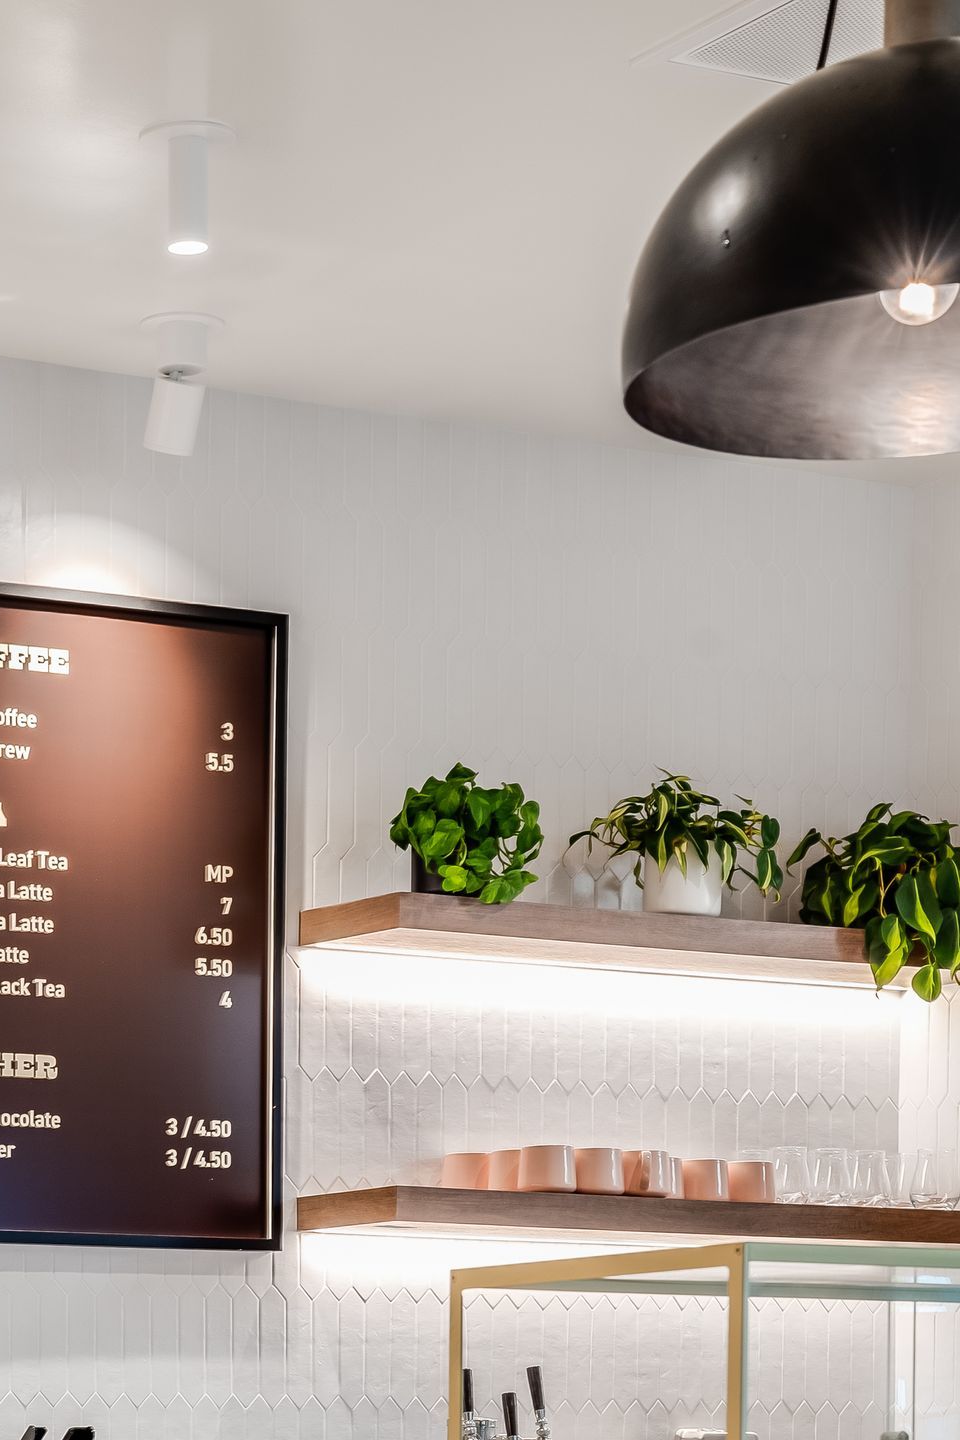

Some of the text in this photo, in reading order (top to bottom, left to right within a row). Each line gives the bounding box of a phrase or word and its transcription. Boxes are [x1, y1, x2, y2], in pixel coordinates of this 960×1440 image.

[220, 723, 234, 741] 3
[205, 752, 234, 772] 5.5
[36, 851, 69, 871] Tea
[205, 864, 234, 884] MP
[8, 880, 53, 902] Latte
[220, 897, 233, 915] 7
[8, 913, 55, 934] Latte
[194, 927, 233, 947] 6.50
[194, 958, 233, 977] 5.50
[32, 978, 65, 998] Tea
[219, 991, 232, 1009] 4
[164, 1115, 232, 1138] 3 / 4.50
[164, 1147, 232, 1170] 3 / 4.50
